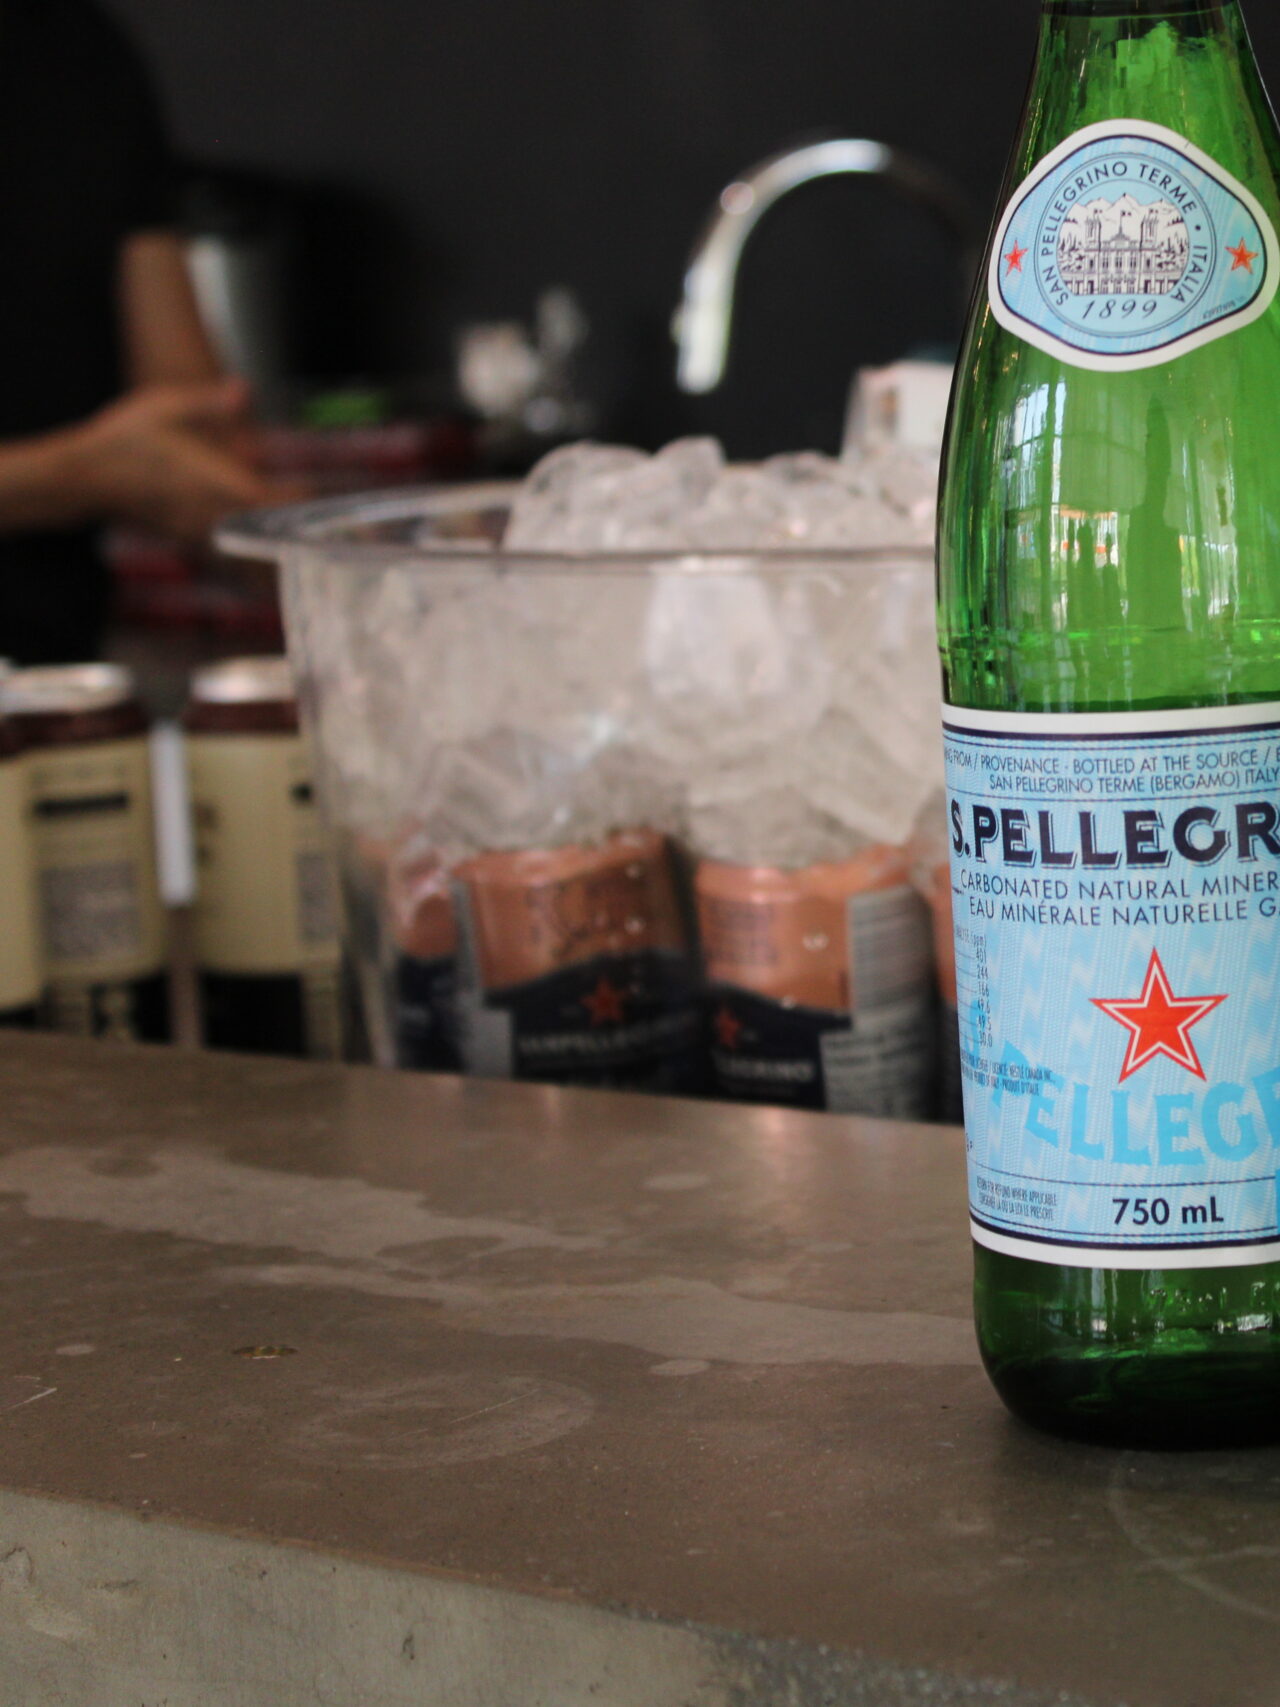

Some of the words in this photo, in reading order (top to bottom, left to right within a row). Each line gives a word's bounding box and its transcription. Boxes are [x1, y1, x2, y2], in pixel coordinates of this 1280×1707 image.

[1138, 163, 1197, 216] TERME
[1041, 160, 1128, 258] PELLEGRINO
[1042, 264, 1069, 307] SAN
[1169, 244, 1208, 304] ITALIA
[1080, 298, 1158, 321] 1899
[980, 754, 1060, 774] PROVENANCE
[1073, 757, 1135, 775] BOTTLED
[1140, 756, 1158, 772] AT
[1163, 754, 1191, 772] THE
[1195, 749, 1259, 770] SOURCE
[989, 773, 1012, 791] SAN
[1015, 776, 1094, 794] PELLEGRINO
[1099, 776, 1145, 794] TERME
[1150, 770, 1240, 795] (BERGAMO)
[1245, 766, 1280, 785] ITALY
[960, 872, 1069, 900] CARBONATED
[1078, 876, 1191, 901] NATURAL
[969, 899, 995, 919] EAU
[1001, 900, 1101, 927] MINÉRALE
[1112, 900, 1248, 927] NATURELLE
[1111, 1198, 1170, 1226] 750
[1180, 1196, 1224, 1225] mL
